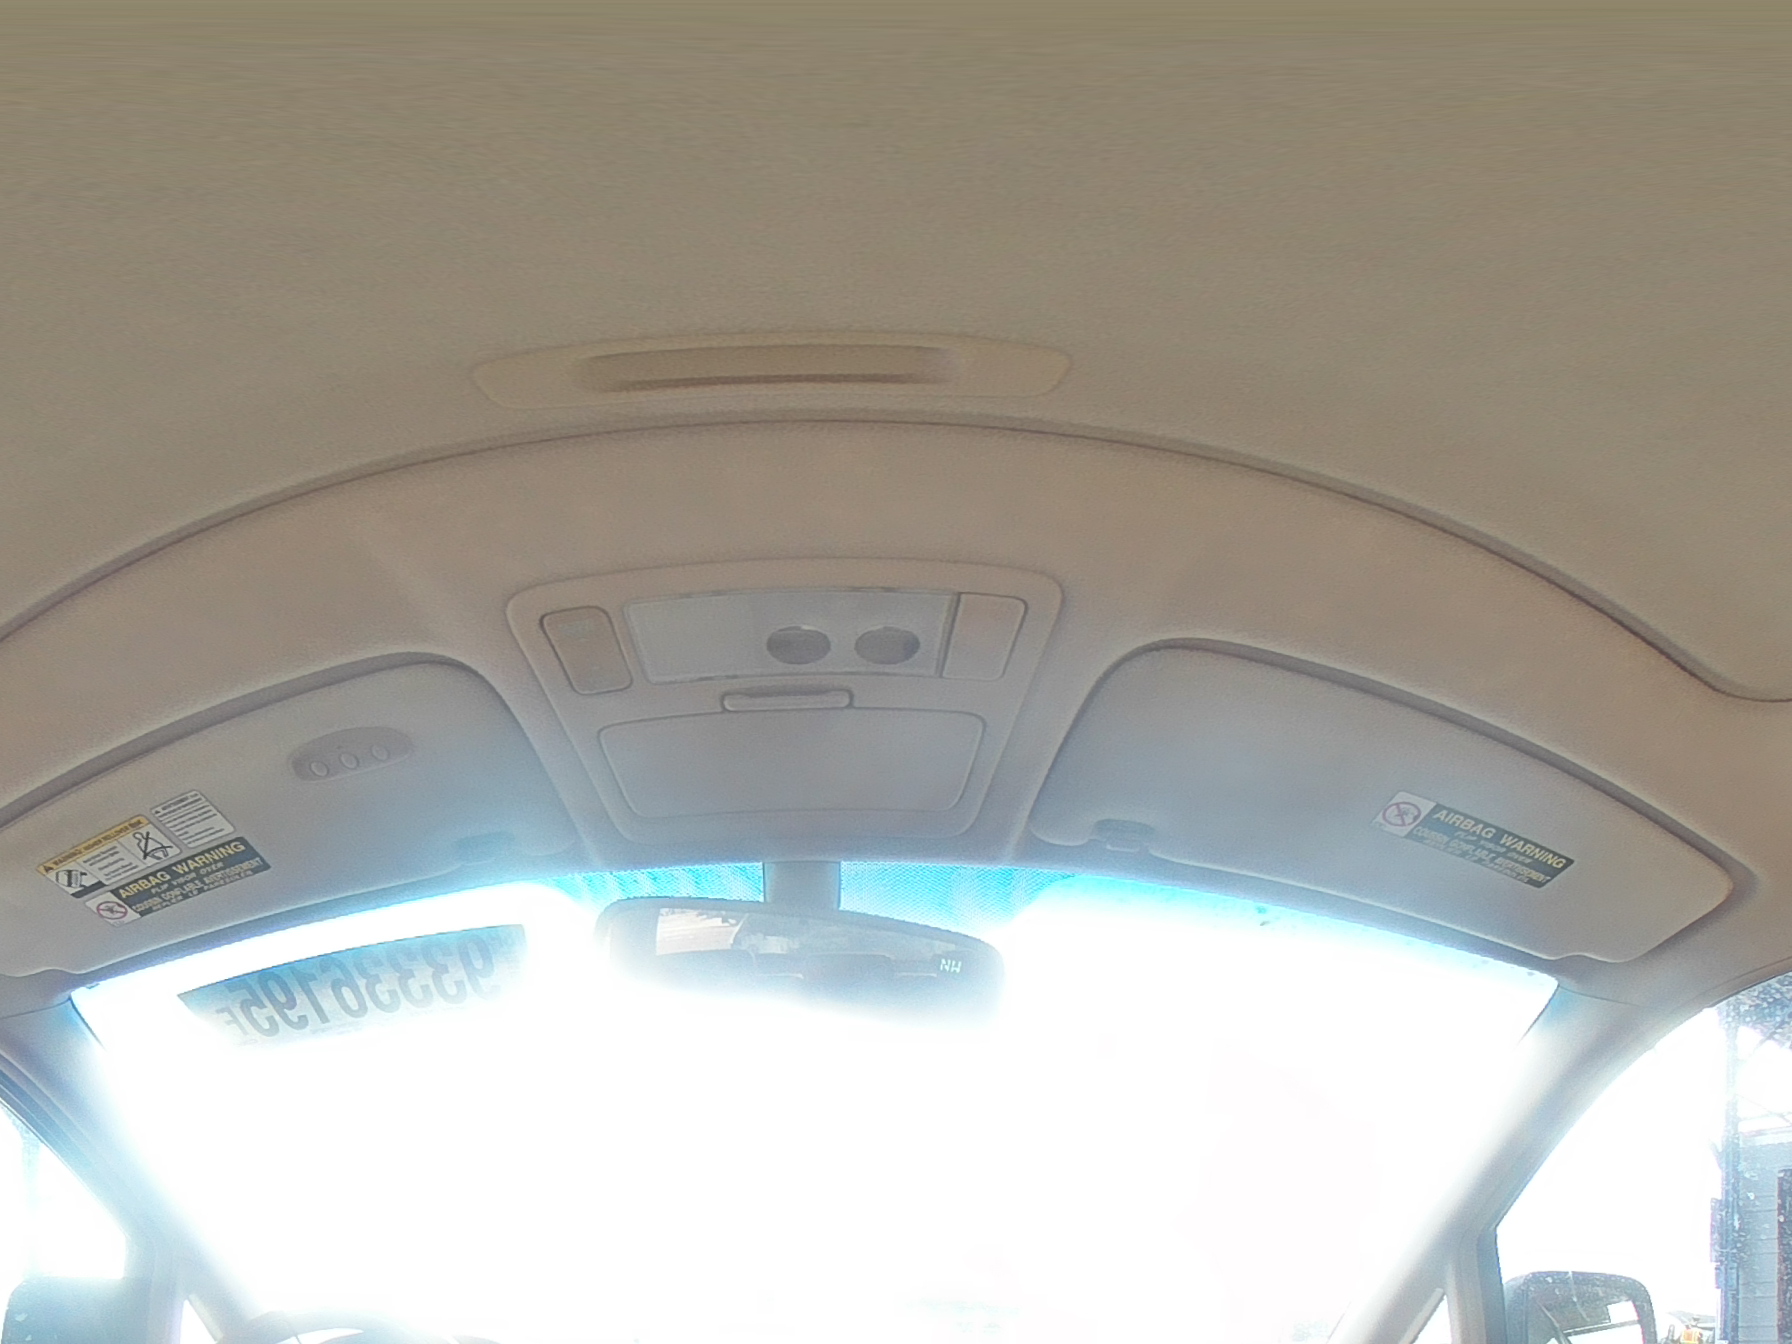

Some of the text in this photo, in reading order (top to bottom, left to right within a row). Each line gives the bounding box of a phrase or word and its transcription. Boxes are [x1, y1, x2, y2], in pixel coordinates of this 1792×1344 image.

[1433, 809, 1496, 839] AIRBAG
[1499, 834, 1567, 869] WARNING
[118, 870, 170, 898] AIRBAG
[171, 840, 246, 875] WARNING
